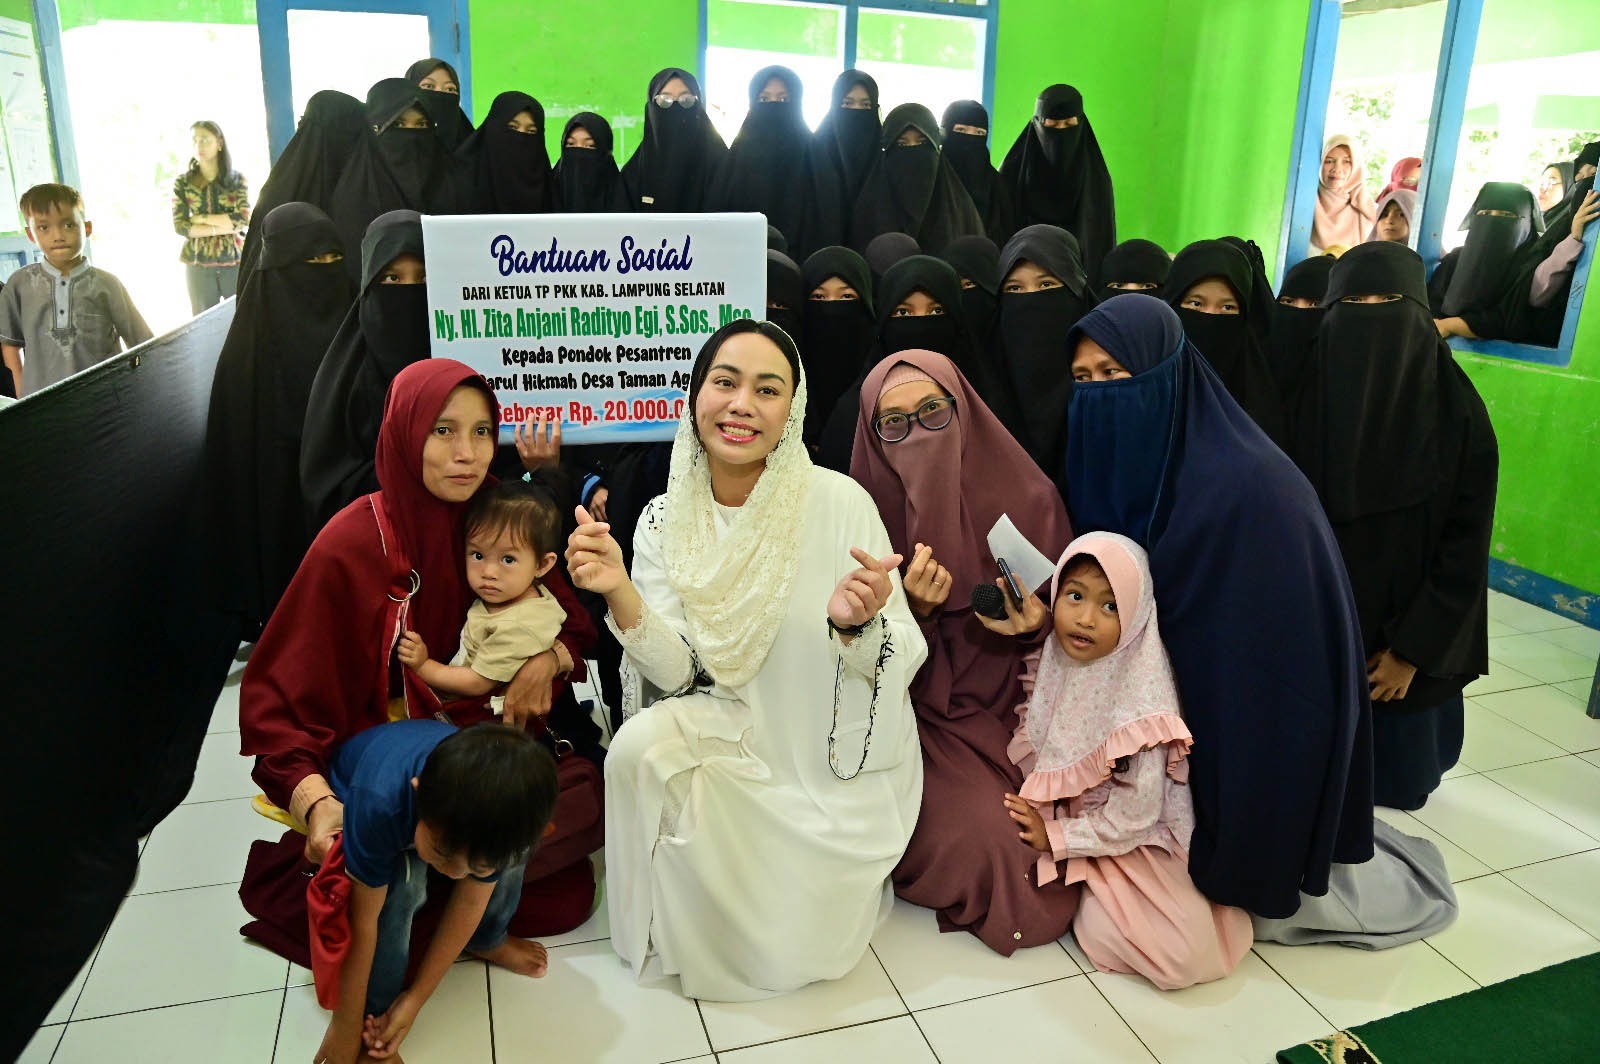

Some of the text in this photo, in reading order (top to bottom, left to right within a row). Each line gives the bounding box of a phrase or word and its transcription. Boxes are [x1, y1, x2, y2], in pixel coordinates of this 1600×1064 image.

[490, 234, 693, 276] Bantuan Sosial
[462, 282, 725, 300] DARI KETUA TP PKK KAB. LAMPUNG SELATAN
[434, 309, 459, 342] Ny.
[483, 308, 513, 338] Zita
[516, 307, 567, 340] Anjani
[570, 306, 632, 339] Radityo
[634, 305, 663, 338] Egi,
[502, 344, 692, 367] Kepada Pondok Pesantren
[481, 370, 691, 391] arul Hikmah Desa Taman Ag
[569, 401, 598, 425] Rp.
[604, 399, 685, 421] 20.000.0
